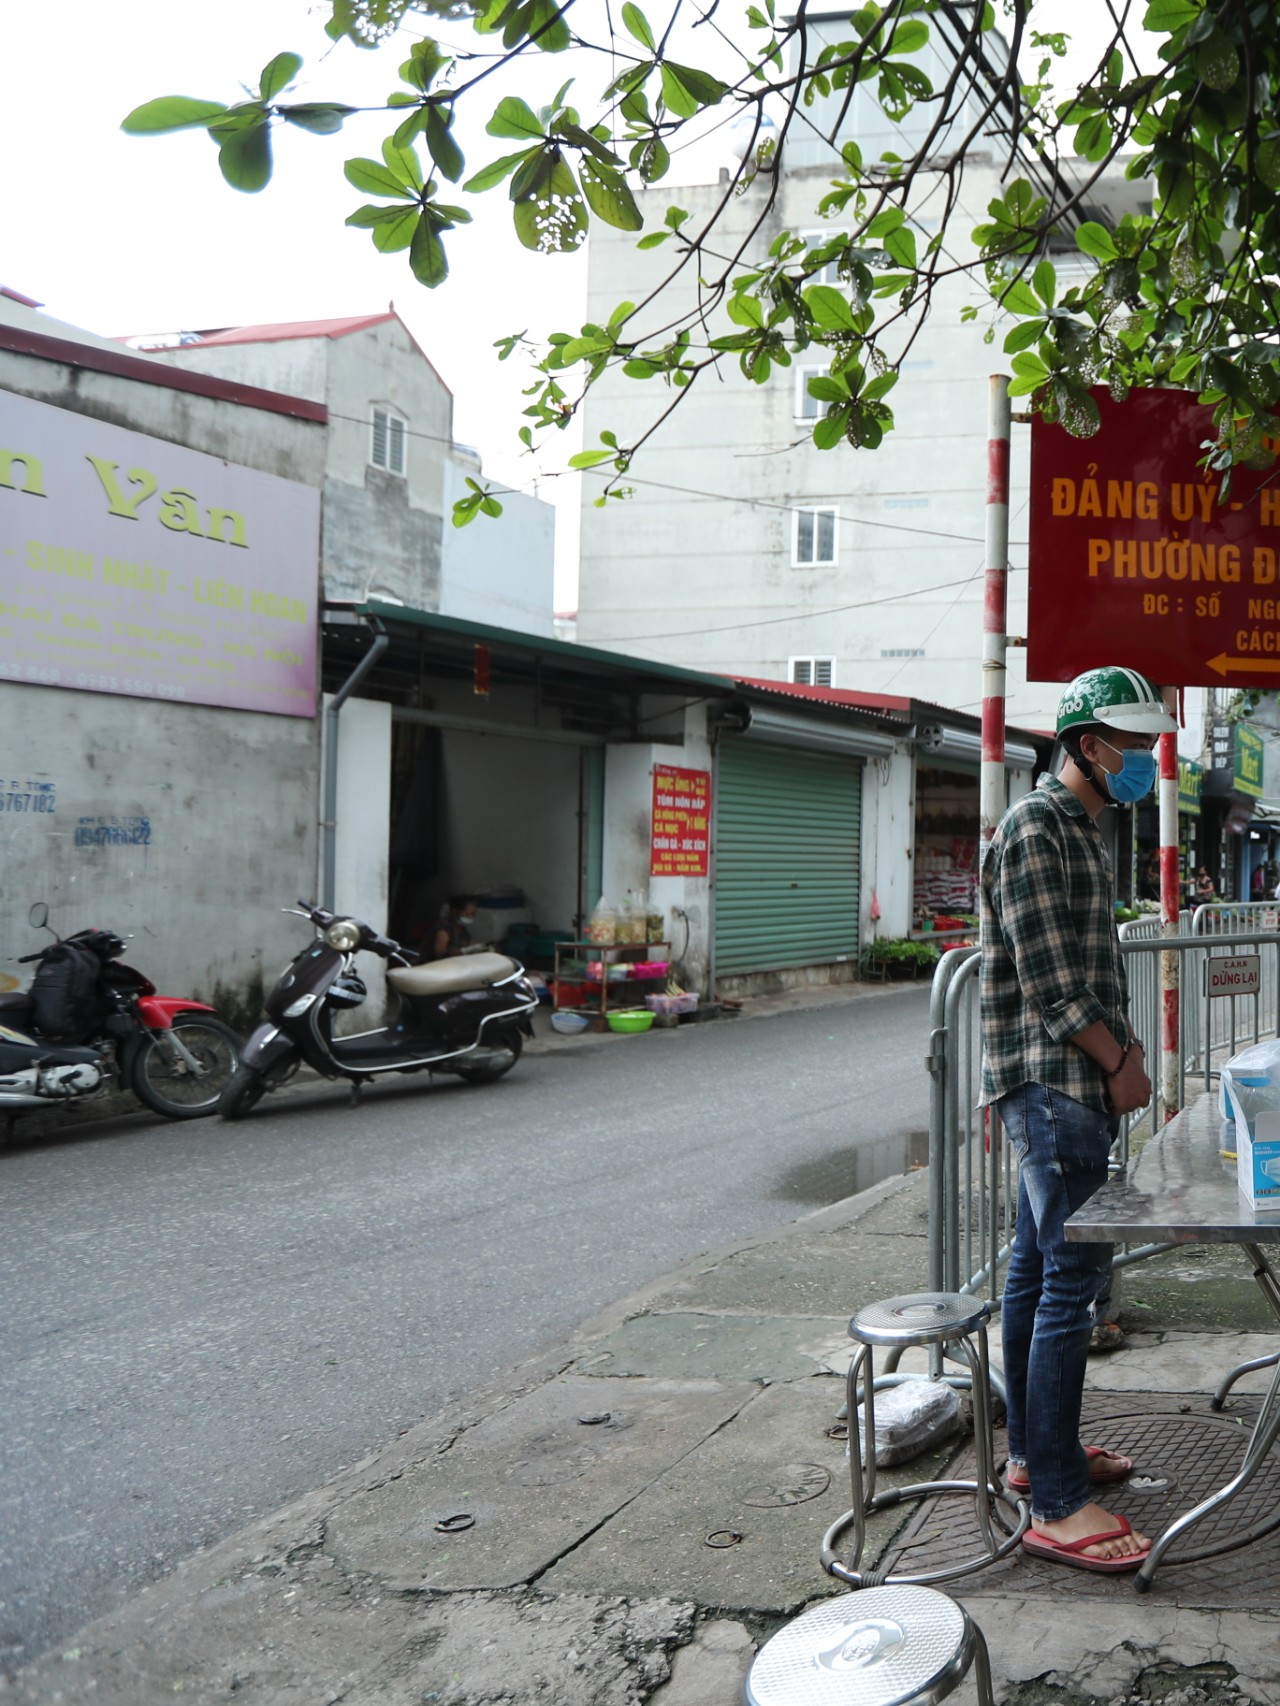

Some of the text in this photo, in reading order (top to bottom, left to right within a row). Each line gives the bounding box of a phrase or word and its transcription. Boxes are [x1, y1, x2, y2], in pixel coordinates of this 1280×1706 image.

[85, 451, 250, 549] Vân
[1051, 462, 1159, 520] ĐẢNG
[1171, 471, 1219, 523] UỶ
[26, 540, 95, 582] SINH
[193, 576, 244, 613] LIÊN
[251, 588, 308, 625] HOAN
[1088, 531, 1241, 583] PHƯỜNG
[1143, 593, 1169, 615] ĐC
[1195, 591, 1221, 618] SỐ
[1212, 970, 1258, 987] DỪNG LẠI
